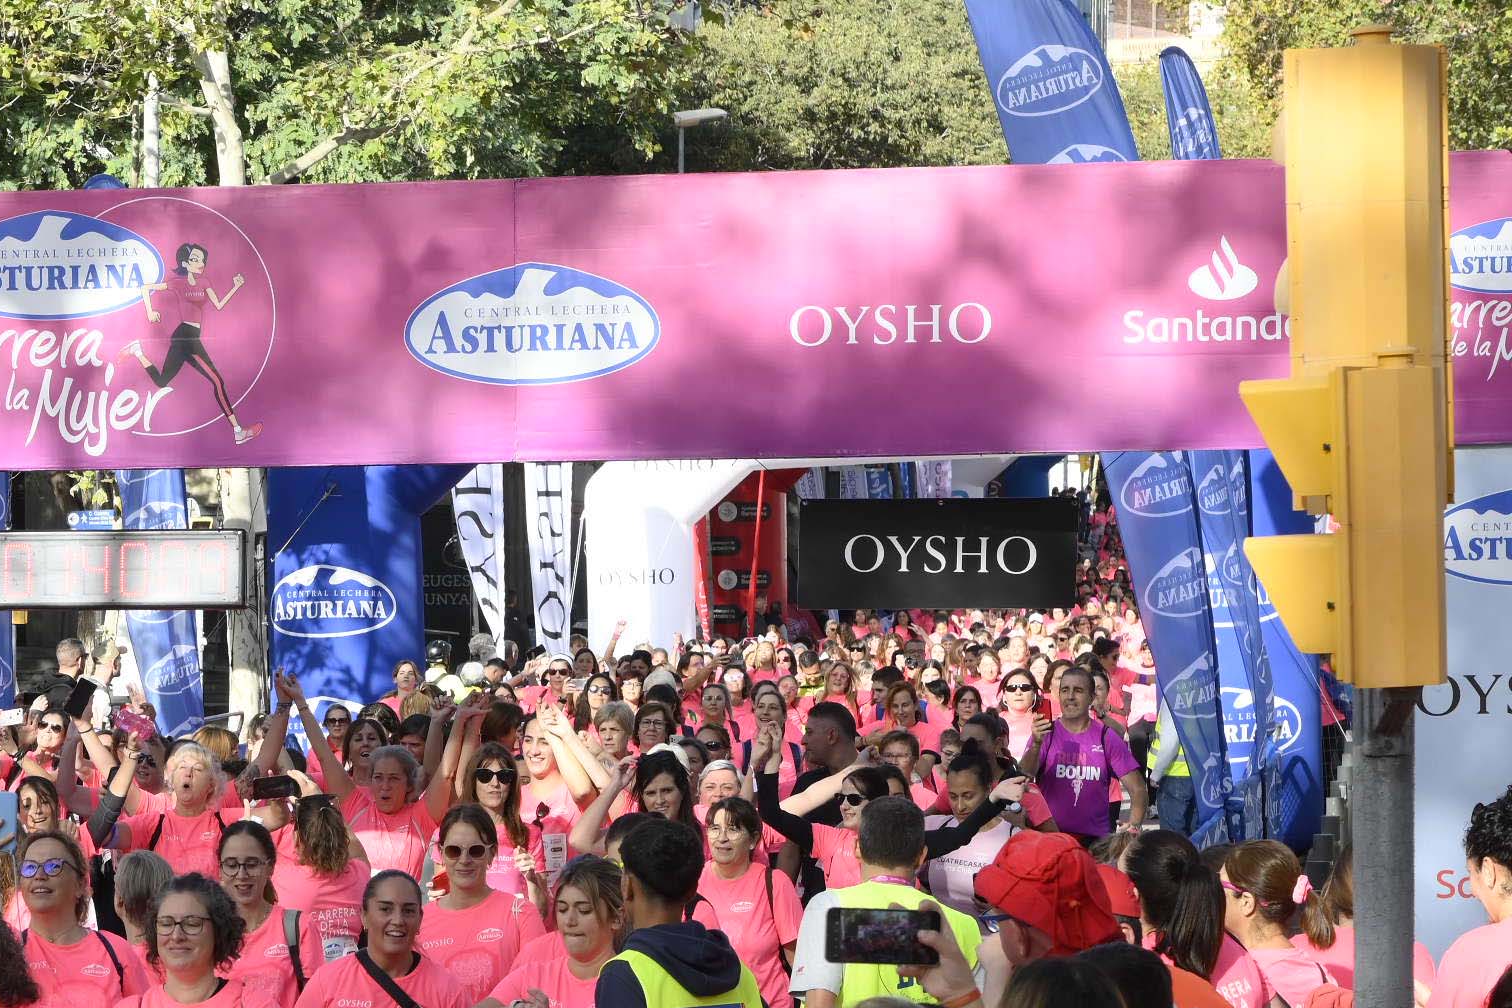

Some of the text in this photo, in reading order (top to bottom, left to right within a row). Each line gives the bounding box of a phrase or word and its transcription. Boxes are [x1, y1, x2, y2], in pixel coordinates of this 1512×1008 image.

[66, 247, 139, 258] LECHERA
[464, 304, 632, 318] CENTRAL LECHERA
[425, 310, 640, 355] ASTURIANA
[789, 302, 992, 347] OYSHO
[5, 370, 30, 411] la
[25, 361, 174, 457] Mujer
[1470, 522, 1512, 532] CENT
[844, 534, 1037, 574] OYSHO
[599, 567, 675, 585] OYSHO
[287, 589, 383, 598] CENTRAL LECHERA
[274, 595, 388, 622] ASTURIANA
[1055, 763, 1101, 781] BOUIN
[311, 906, 357, 923] CARRERA
[1222, 979, 1252, 1000] RERA
[338, 998, 372, 1008] OYSHO
